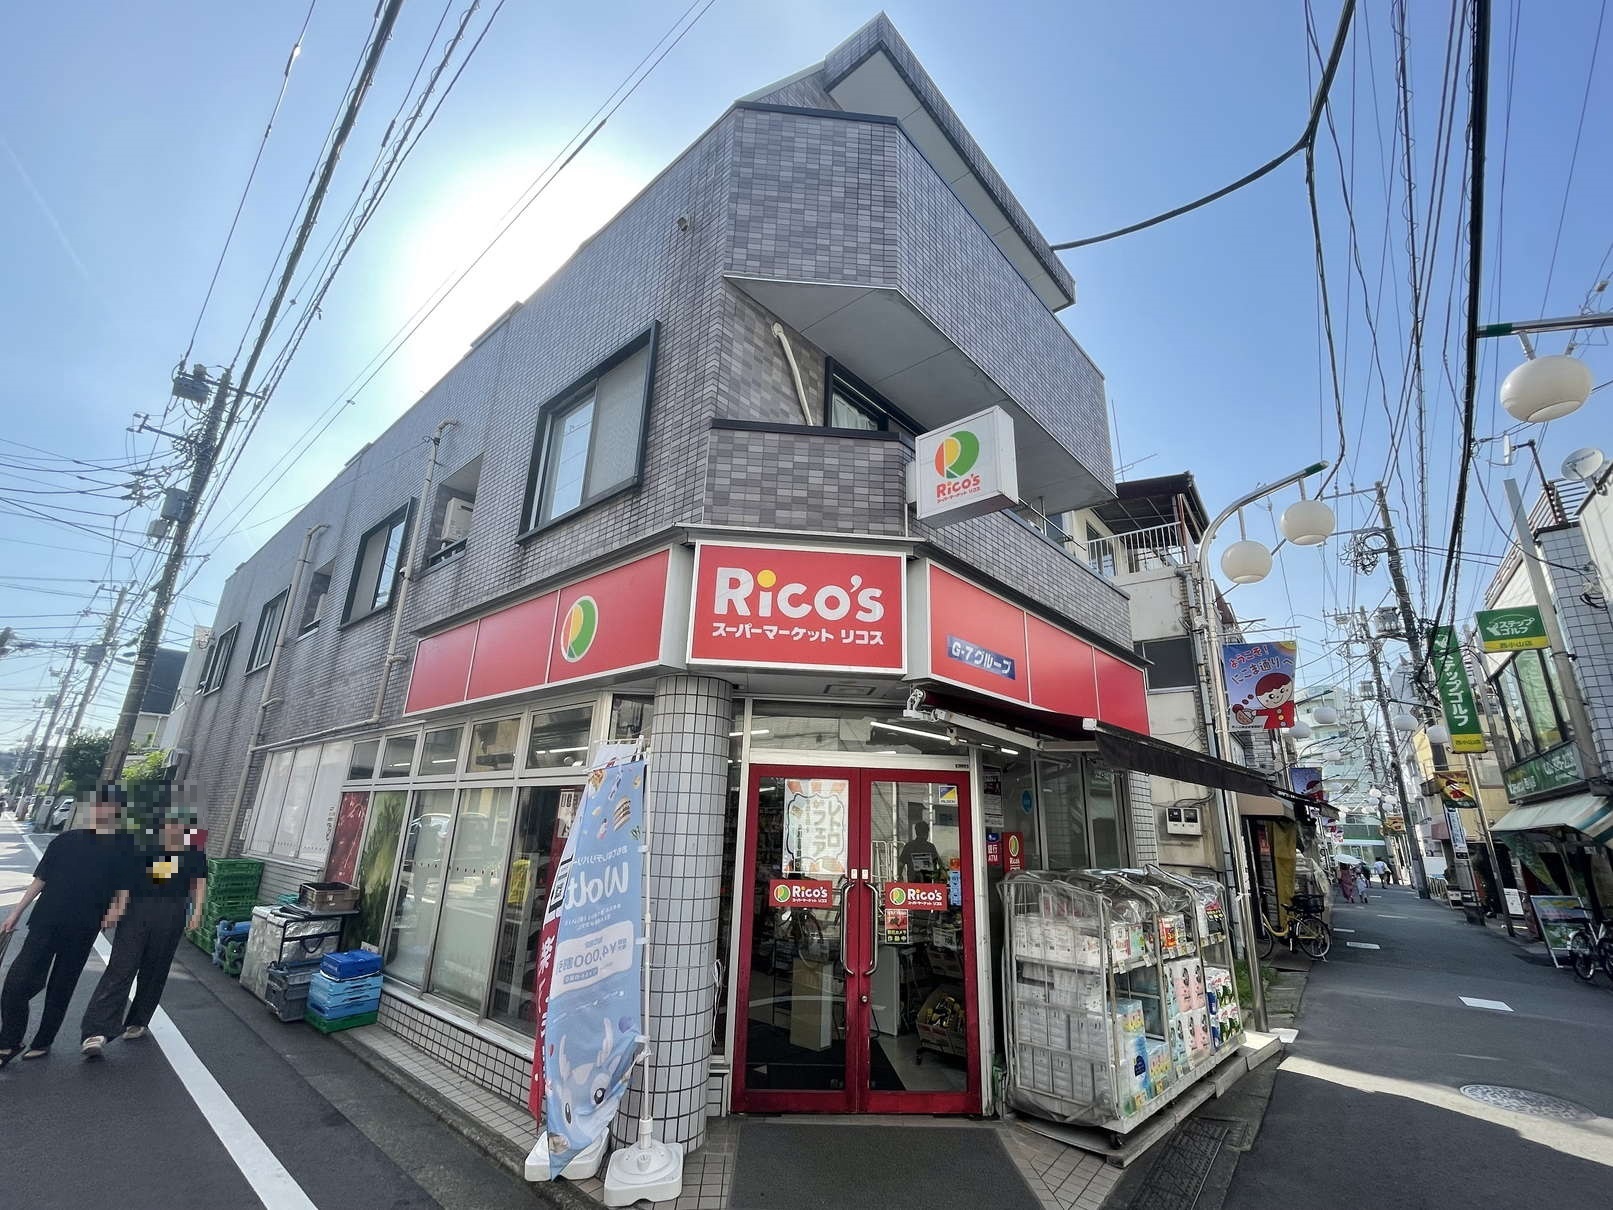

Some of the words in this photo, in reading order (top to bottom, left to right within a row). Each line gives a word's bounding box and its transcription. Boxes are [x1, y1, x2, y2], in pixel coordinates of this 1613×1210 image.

[936, 473, 980, 498] Rico's
[714, 567, 884, 623] Rico's
[1499, 617, 1536, 629] ステップ
[712, 622, 835, 643] スーパーマーケット
[840, 629, 884, 645] リコス
[1501, 626, 1529, 636] ゴルフ
[1231, 656, 1293, 684] にこま通りへ
[987, 854, 999, 863] ATM
[792, 886, 828, 898] Rico's
[907, 888, 943, 901] Rico's
